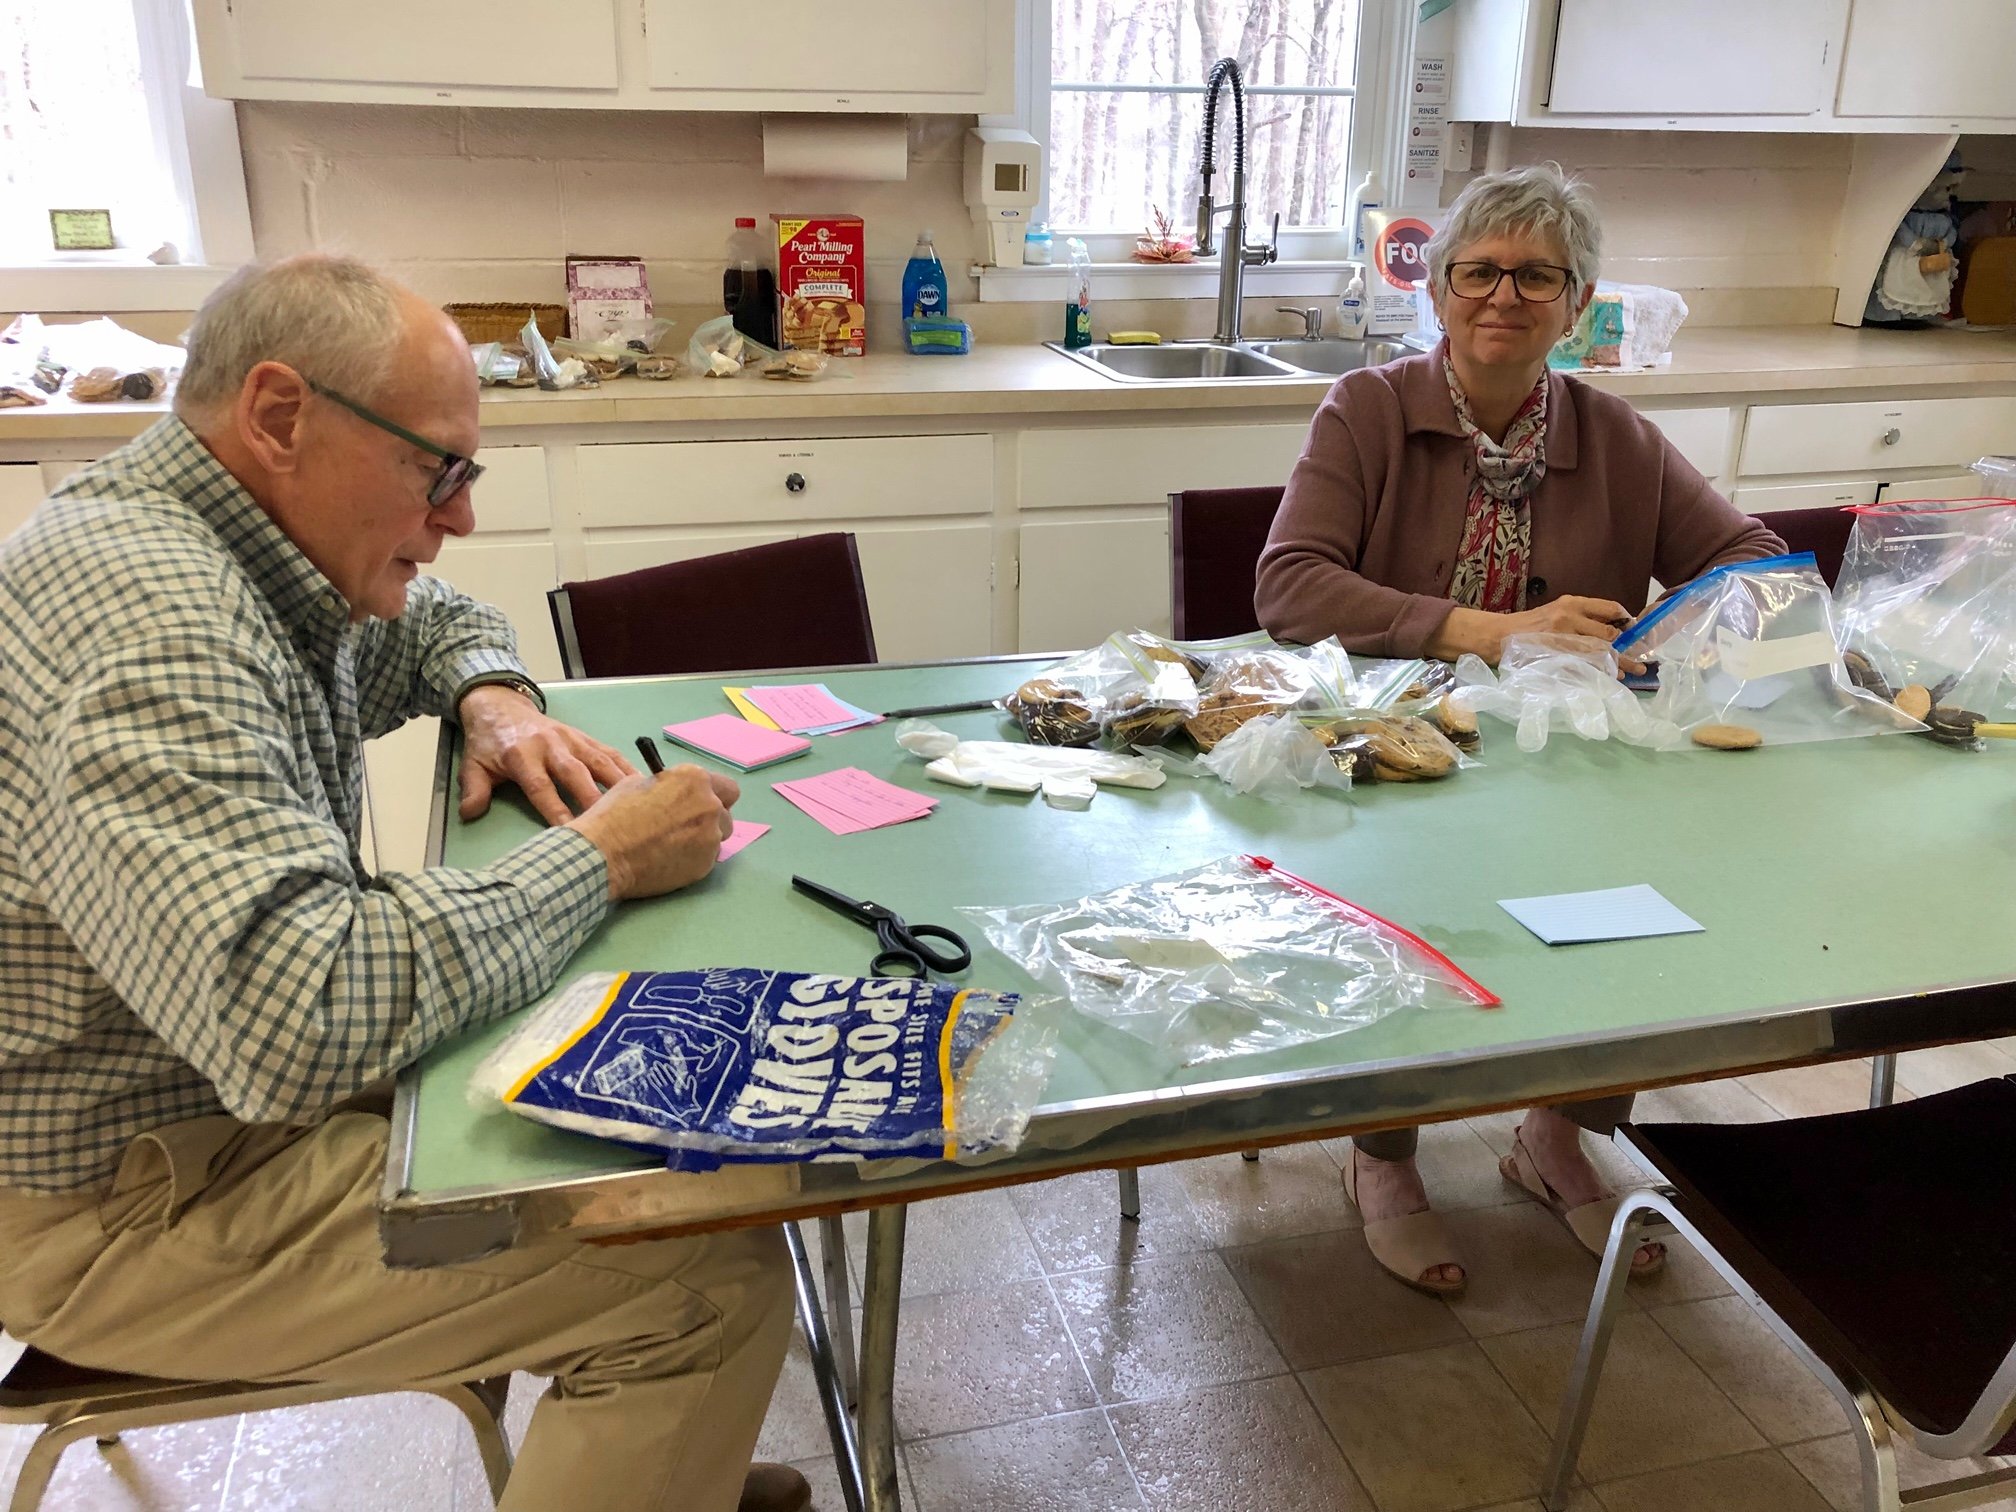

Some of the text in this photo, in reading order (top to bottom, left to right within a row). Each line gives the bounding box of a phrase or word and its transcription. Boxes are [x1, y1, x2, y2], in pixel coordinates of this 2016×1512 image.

[1421, 63, 1443, 71] WASH
[1418, 107, 1440, 115] RINSE
[1409, 149, 1440, 157] SANITIZE
[791, 240, 853, 255] Pearl Milling
[798, 251, 845, 265] Company
[805, 267, 841, 279] Original
[917, 290, 940, 299] DAWN
[905, 1012, 930, 1045] SIZE
[728, 973, 856, 1129] GLOVES
[900, 1051, 922, 1089] FITS
